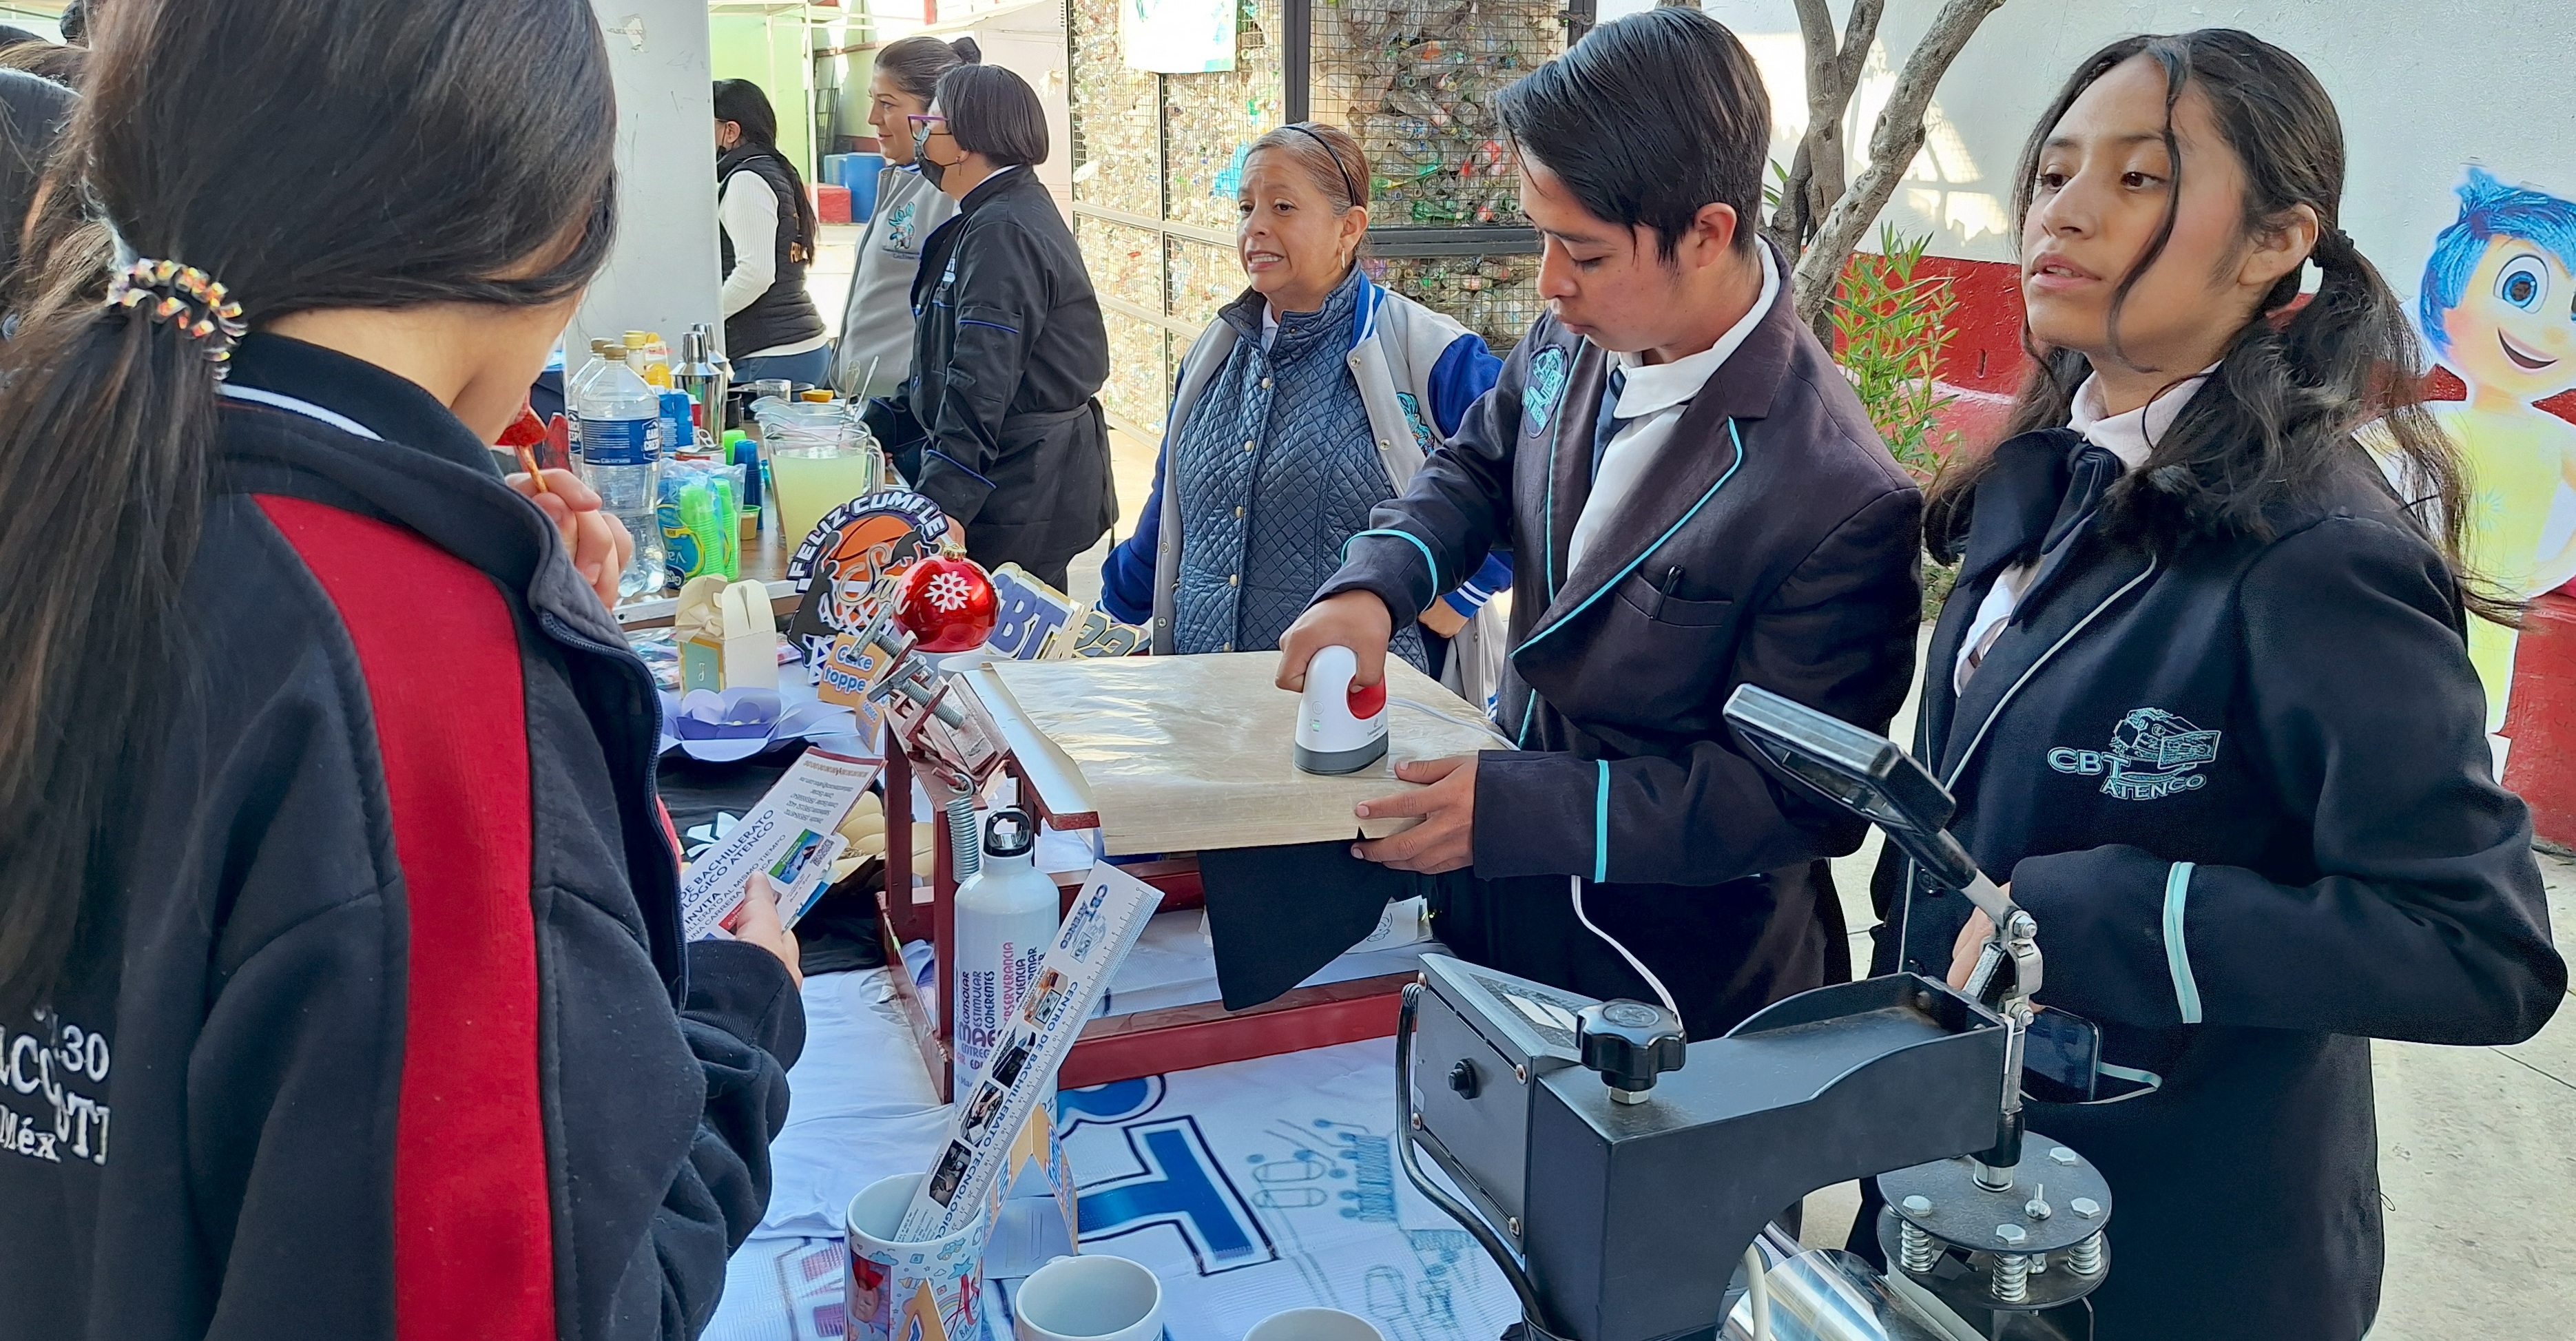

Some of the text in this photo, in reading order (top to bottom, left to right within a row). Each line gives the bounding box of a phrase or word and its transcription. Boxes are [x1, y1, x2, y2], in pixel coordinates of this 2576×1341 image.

[644, 439, 660, 451] CRES
[788, 507, 847, 577] FELIZ
[824, 666, 866, 692] toppe
[2048, 747, 2130, 779] CBT
[2099, 773, 2206, 800] ATENCO
[681, 822, 773, 908] LÓGICO ATENCO
[694, 810, 773, 884] BACHILLERATO
[724, 889, 734, 898] AL
[734, 863, 758, 888] MISMO
[758, 835, 786, 862] TIEMPO
[685, 892, 721, 924] INVITA
[705, 891, 742, 925] CARRERA
[1060, 900, 1089, 950] ATENCO
[1086, 884, 1108, 922] CBT
[973, 970, 982, 1028] ESTIMULAR
[1003, 942, 1015, 1026] ERSERVERANCIA
[1046, 980, 1078, 1032] CENTRO
[962, 1043, 990, 1059] ENTREG
[1035, 1034, 1048, 1051] DE
[981, 1054, 1037, 1147] BACHILLERATO
